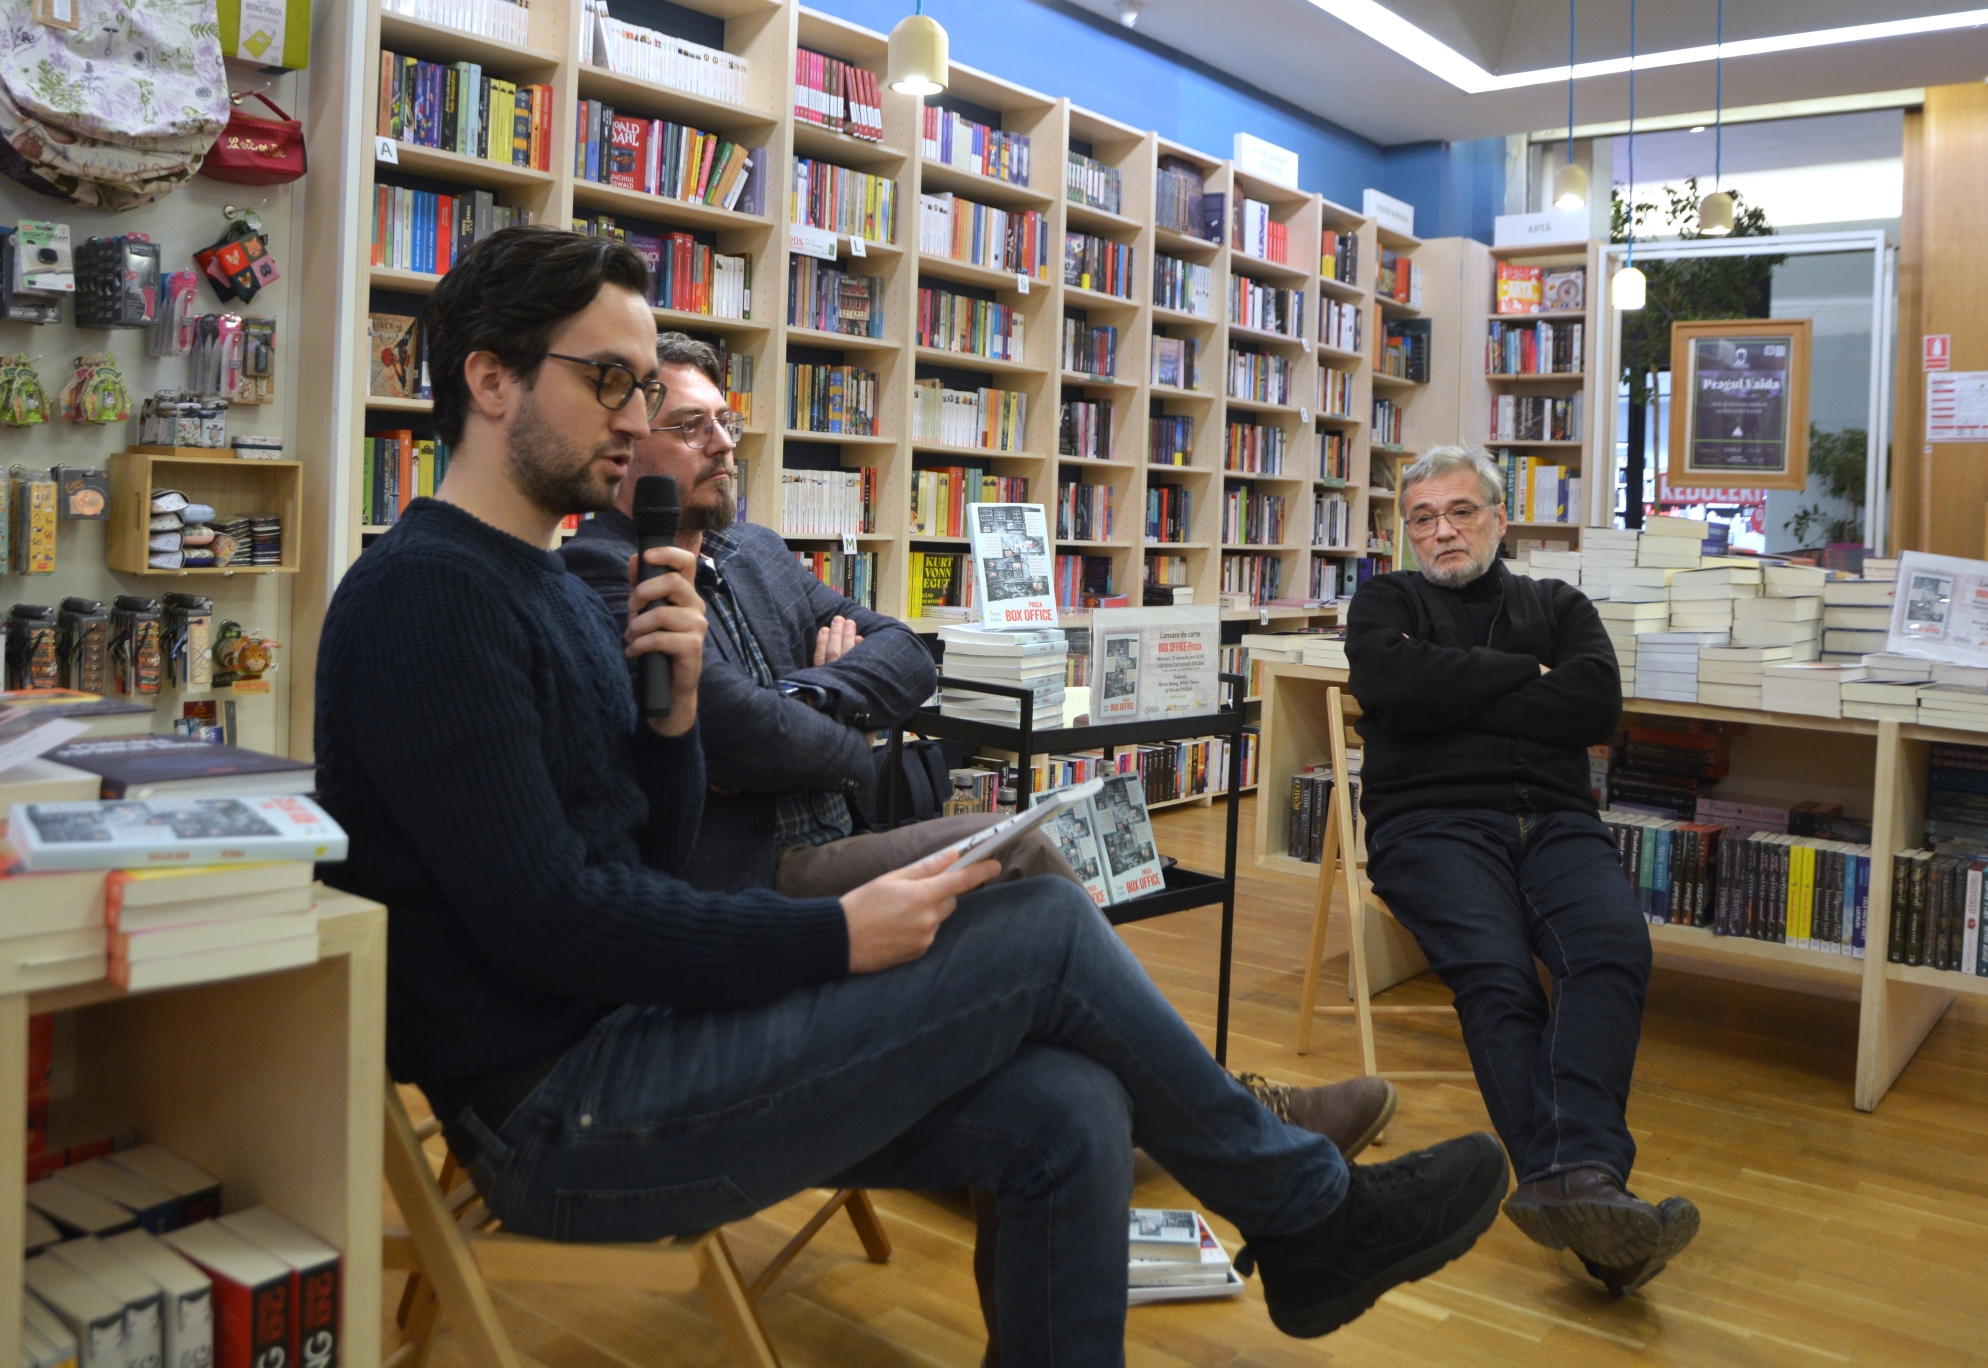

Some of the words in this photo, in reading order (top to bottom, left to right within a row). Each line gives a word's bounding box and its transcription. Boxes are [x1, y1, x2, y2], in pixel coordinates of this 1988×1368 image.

[381, 142, 393, 158] A
[853, 240, 862, 252] L
[1020, 278, 1027, 290] S
[1702, 377, 1743, 392] Pragul
[845, 538, 855, 551] M
[925, 556, 954, 568] KURT
[924, 567, 952, 578] VONN
[923, 578, 951, 589] EGUT
[1005, 609, 1023, 622] BOX
[1024, 609, 1053, 622] OFFICE
[1181, 630, 1187, 638] de
[1158, 642, 1169, 653] BOX
[1170, 641, 1187, 652] OFFICE
[1188, 641, 1202, 651] Proza
[1110, 703, 1119, 712] BOX
[1119, 702, 1134, 711] OFFICE
[1125, 879, 1140, 894] BOX
[1139, 873, 1161, 890] OFFICE
